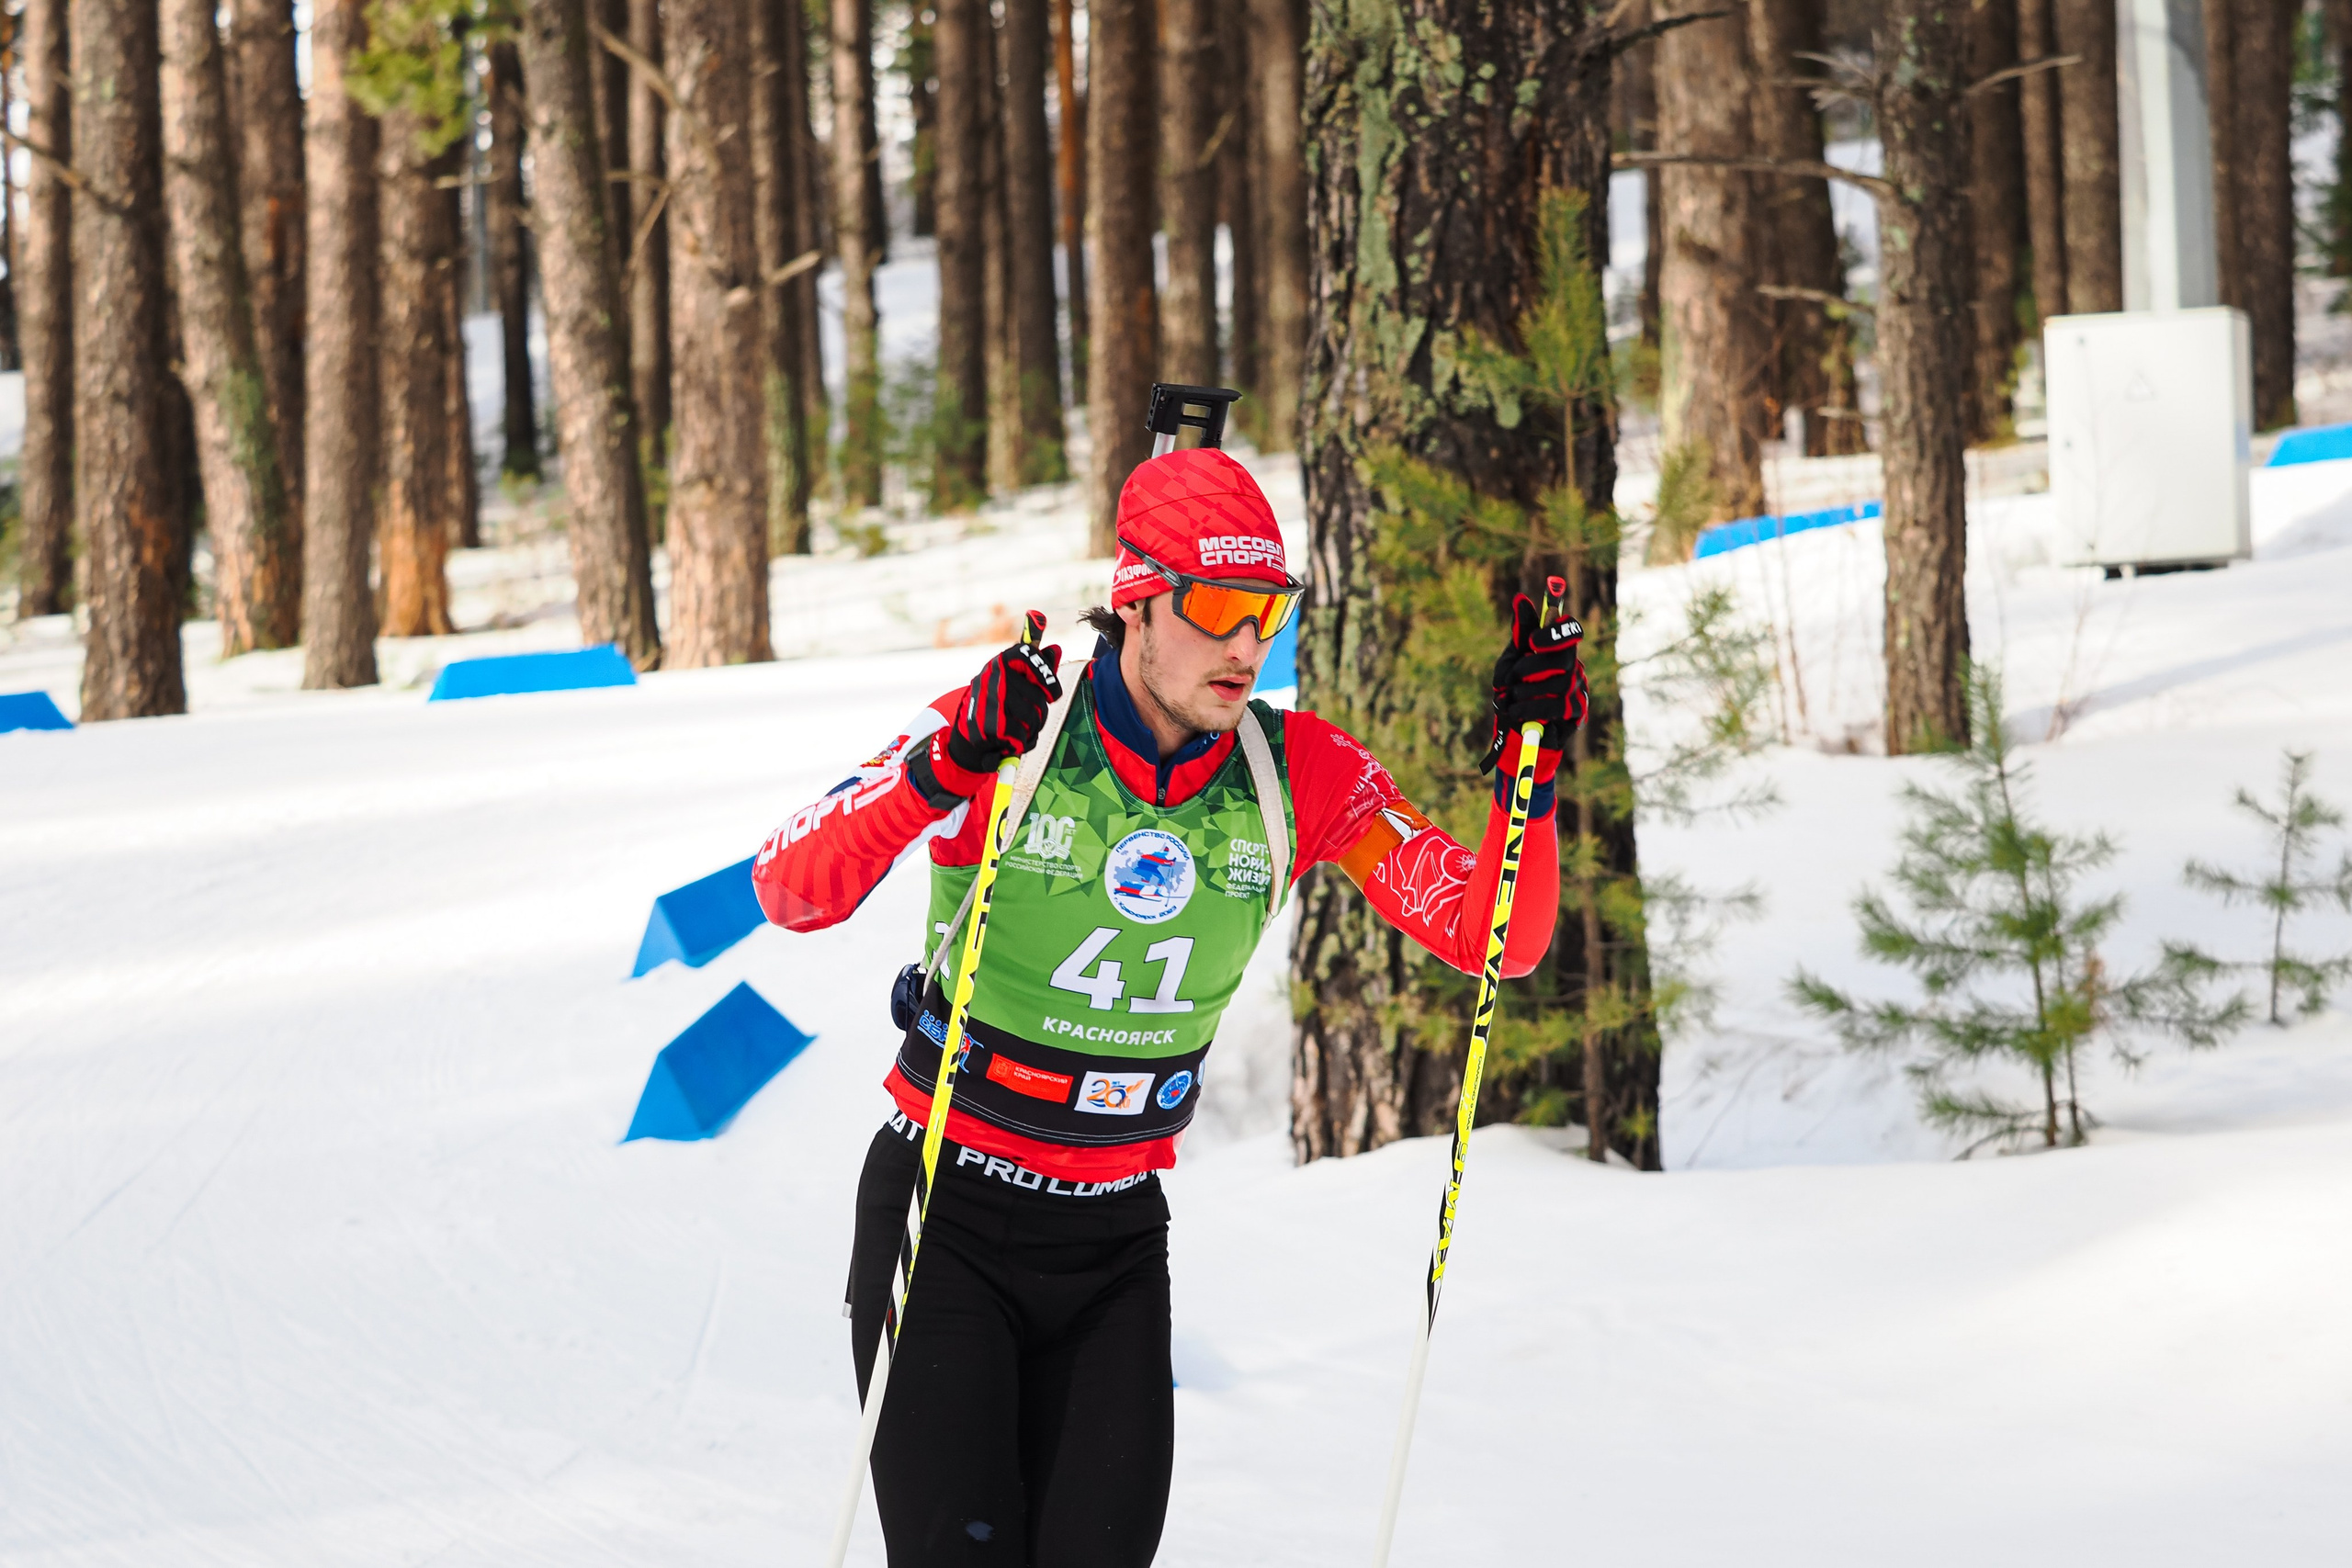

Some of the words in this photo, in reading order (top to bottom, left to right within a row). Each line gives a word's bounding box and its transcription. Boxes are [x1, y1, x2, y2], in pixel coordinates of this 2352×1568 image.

[1200, 550, 1275, 568] СПОРТ
[1019, 644, 1057, 685] LEKI
[756, 784, 863, 866] СПОРТ
[1115, 831, 1166, 853] ПЕРВЕНСТВО
[1497, 764, 1535, 906] ONE
[1048, 926, 1195, 1014] 41
[1474, 919, 1510, 1046] WAY
[1042, 1016, 1178, 1046] КРАСНОЯРСК
[1013, 1071, 1032, 1081] КРАЙ
[1014, 1066, 1069, 1085] КРАСНОЯРСКИЙ
[956, 1145, 1042, 1190] PRO
